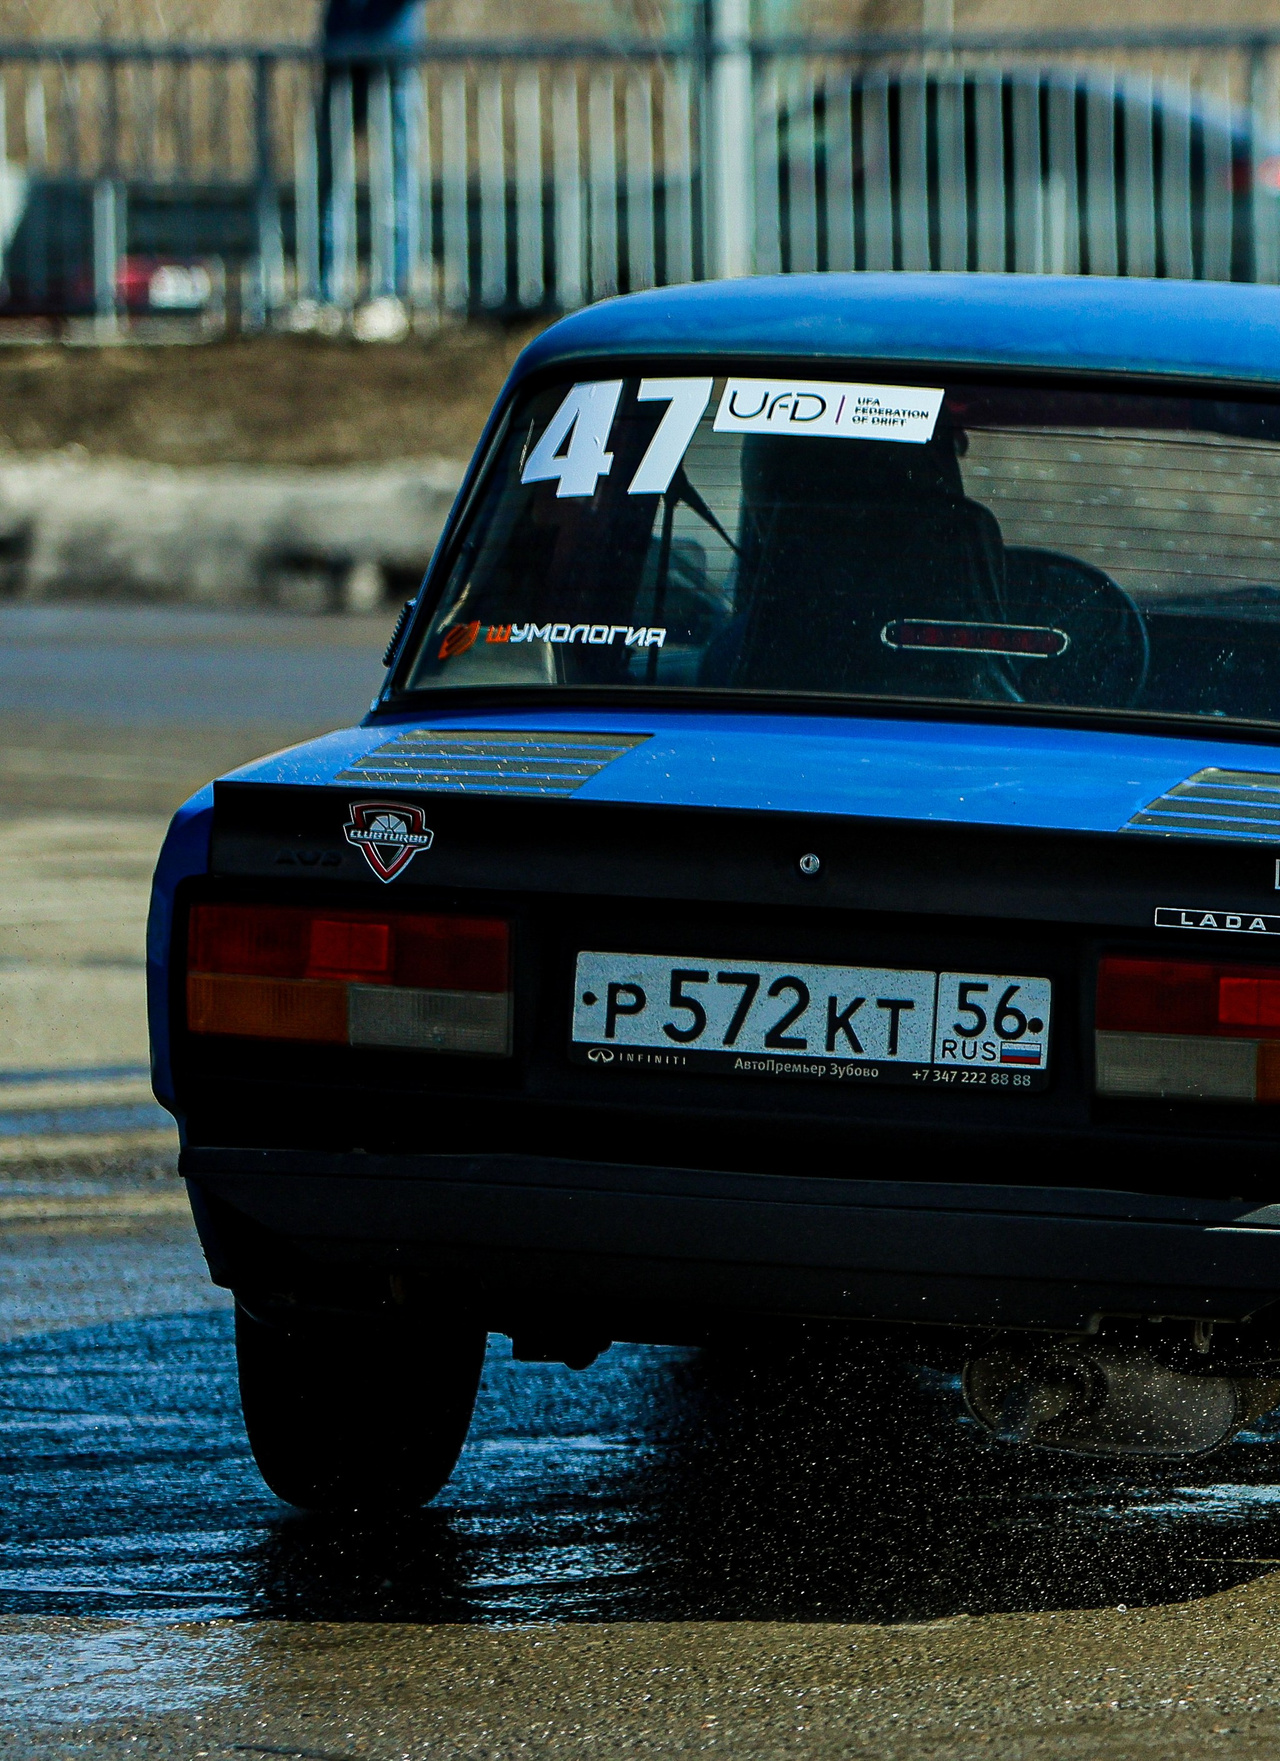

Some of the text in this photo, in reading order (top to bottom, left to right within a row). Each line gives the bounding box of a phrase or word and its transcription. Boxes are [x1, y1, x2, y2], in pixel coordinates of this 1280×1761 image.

[729, 389, 827, 422] UFD
[857, 396, 881, 407] UFA
[851, 415, 907, 428] OF DRIFT
[854, 405, 930, 419] FEDERATION
[522, 377, 713, 498] 47
[485, 623, 667, 648] ШУМОЛОГИЯ
[349, 829, 429, 845] CLUBTURBO
[1180, 912, 1267, 931] LADA
[953, 982, 1029, 1041] 56
[619, 1052, 687, 1066] INFINITI
[941, 1039, 998, 1061] RUS
[734, 1057, 879, 1079] АвтоПремьер Зубово
[912, 1069, 1032, 1087] +7 347 222 88 88
